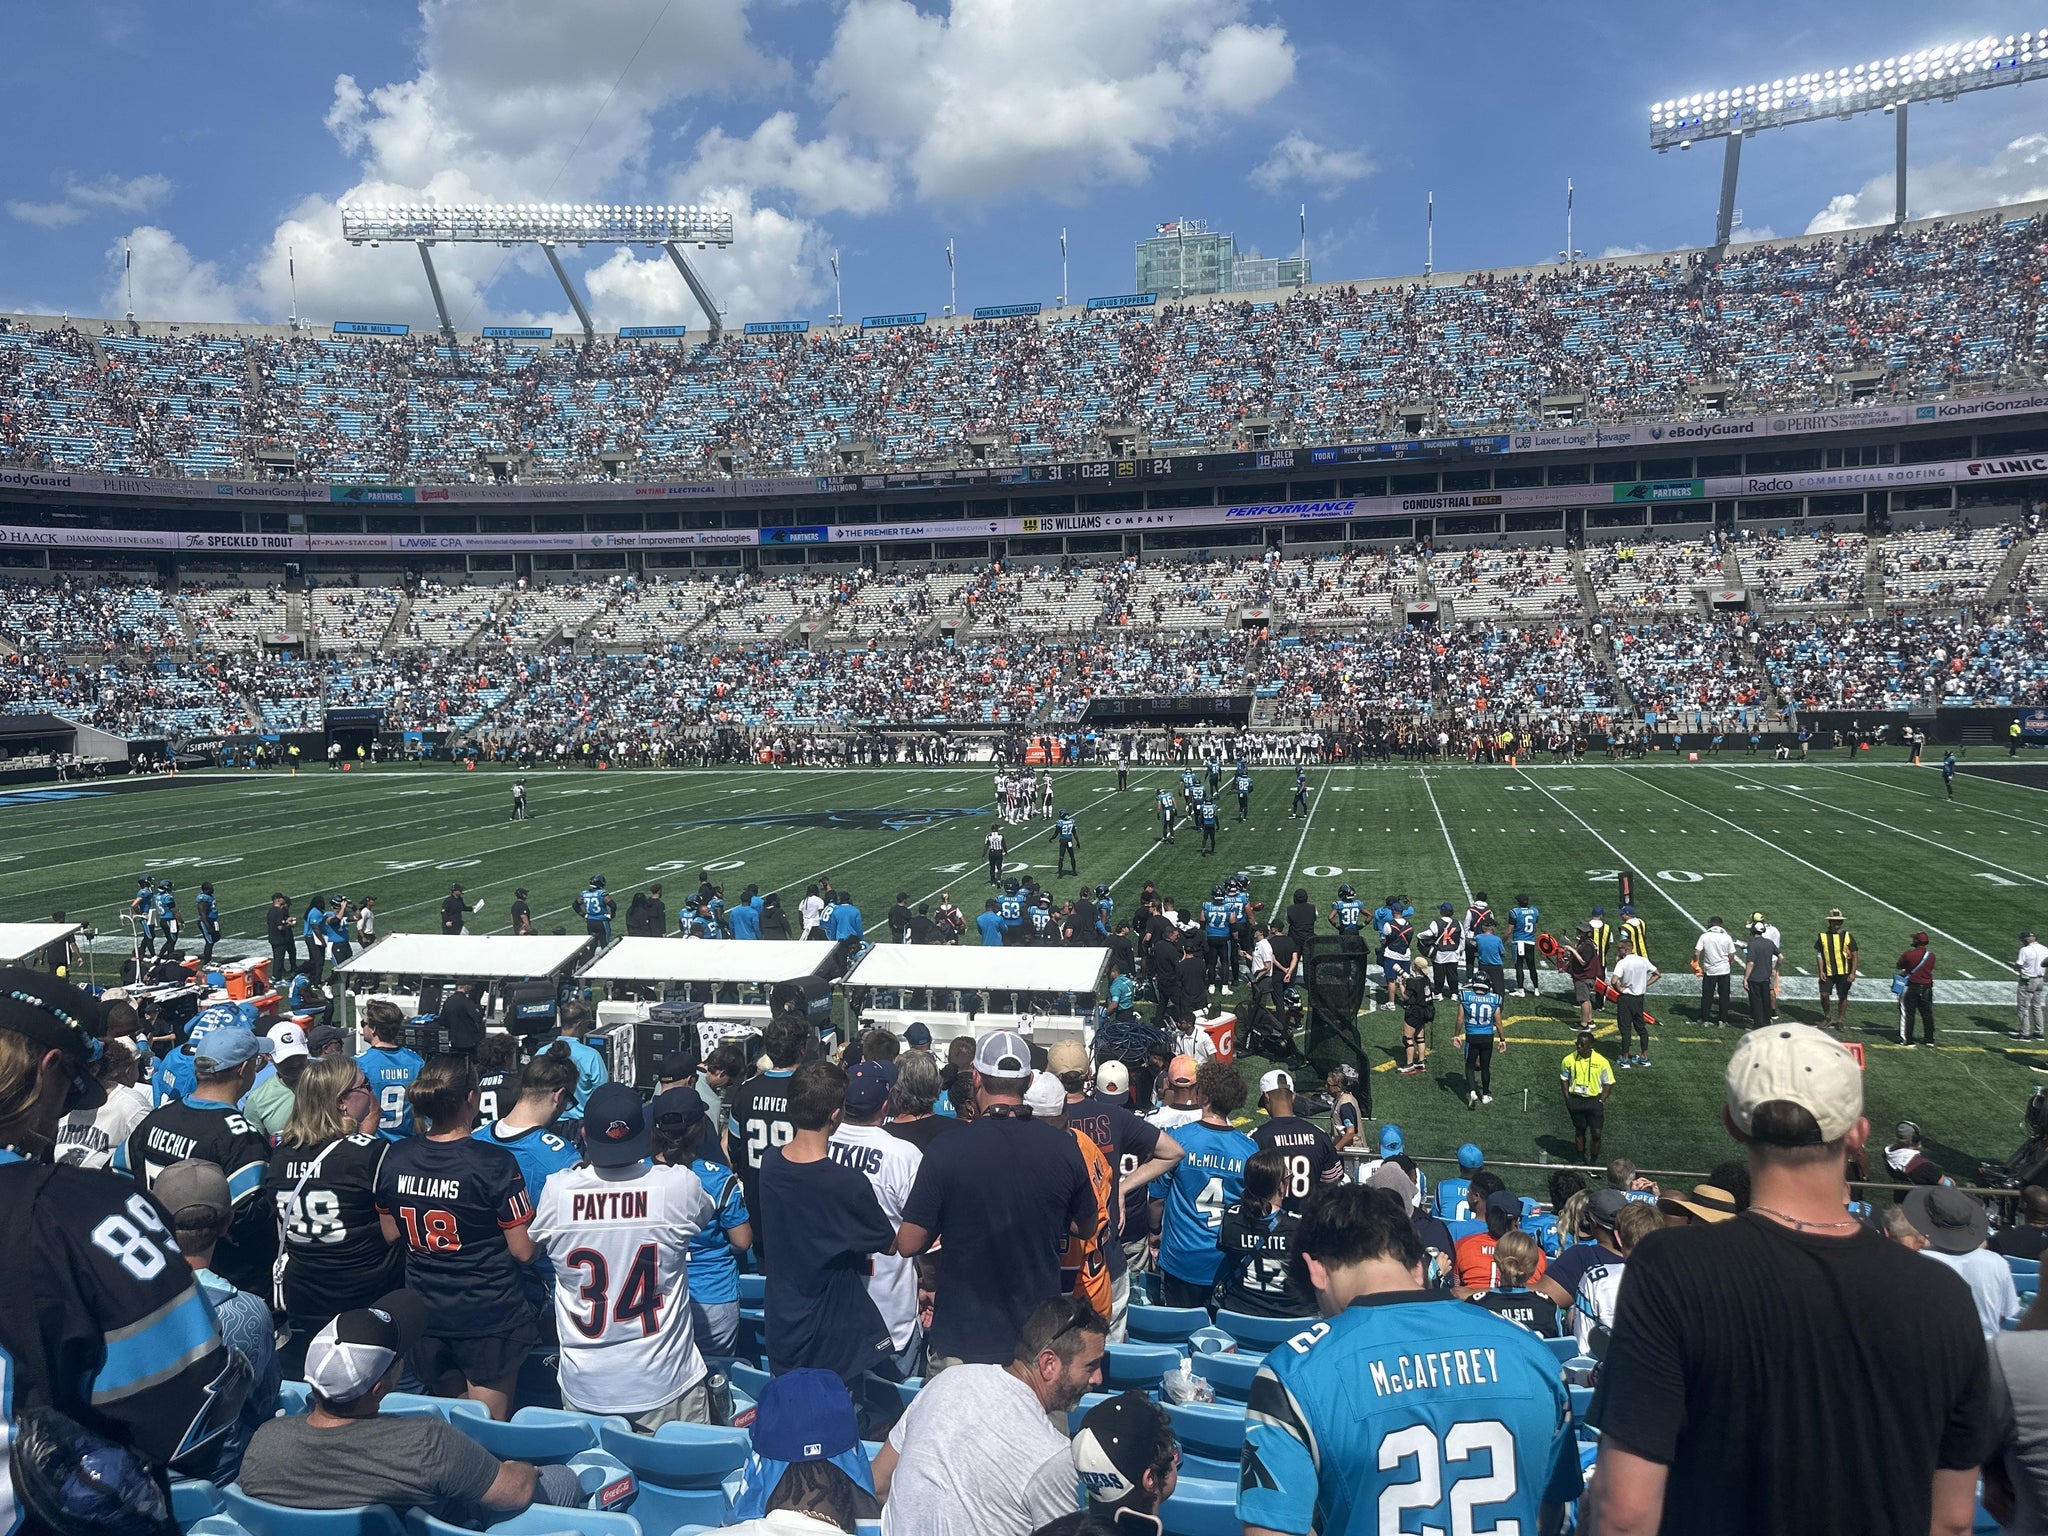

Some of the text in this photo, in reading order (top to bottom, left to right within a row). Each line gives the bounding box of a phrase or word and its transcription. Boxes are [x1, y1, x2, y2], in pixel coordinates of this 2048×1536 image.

[1095, 296, 1149, 307] JULIUS PEPPERS
[1002, 306, 1038, 315] MUHAMMAD
[897, 316, 917, 324] WALLS
[371, 325, 391, 333] MILLS
[1787, 415, 1839, 431] PERRY'S
[1839, 411, 1881, 420] DIAMONDS
[1839, 416, 1900, 426] ESTATE JEWELRY
[1668, 421, 1754, 438] eBodyGuard
[1535, 435, 1562, 447] Laxer,
[1563, 434, 1587, 448] Long
[1594, 431, 1631, 443] Savage
[1272, 450, 1294, 459] JALEN
[1314, 452, 1335, 461] TODAY
[1344, 446, 1376, 454] RECEPTIONS
[1259, 455, 1271, 466] 18
[1272, 458, 1295, 467] COKER
[1048, 466, 1063, 480] 31
[1081, 463, 1110, 477] 0:22
[1118, 461, 1134, 475] 25
[1153, 459, 1172, 474] 24
[817, 481, 827, 491] 14
[828, 483, 857, 492] RAYMOND
[1749, 468, 1946, 492] Radco COMMERCIAL ROOFING
[236, 486, 323, 498] KohariGonzalez
[368, 492, 403, 501] PARTNERS
[668, 486, 716, 494] ELECTRICAL
[1653, 488, 1692, 498] PARTNERS
[1226, 501, 1358, 517] PERFORMANCE
[1402, 496, 1471, 510] CONDUSTRIAL
[1040, 514, 1175, 531] HS WILLIAMS COMPANY
[10, 532, 58, 544] HAACK
[66, 535, 114, 543] DIAMONDS
[118, 536, 139, 544] FINE
[140, 537, 164, 545] GEMS
[606, 532, 751, 546] Fisher Improvement Technologies
[789, 532, 819, 542] PARTNERS
[845, 529, 863, 537] THE
[863, 528, 899, 537] PREMIER
[901, 527, 924, 536] TEAM
[186, 534, 294, 548] The SPECKLED TROUT
[440, 538, 462, 547] CPA
[1113, 698, 1231, 713] 31 0:22 25 24
[1061, 823, 1074, 835] 27
[1239, 865, 1343, 877] 30
[584, 897, 602, 914] 73
[1001, 901, 1020, 919] 63
[1208, 911, 1228, 928] 77
[1341, 908, 1360, 925] 30
[1523, 915, 1534, 933] 6
[1467, 1003, 1493, 1026] 10
[1218, 1032, 1233, 1056] G
[379, 1067, 409, 1080] YOUNG
[379, 1085, 407, 1130] 9
[752, 1096, 788, 1113] CARVER
[147, 1126, 198, 1160] KUECHLY
[541, 1132, 566, 1152] 9
[1273, 1133, 1315, 1147] WILLIAMS
[828, 1140, 883, 1175] TKUS
[1187, 1152, 1242, 1174] McMILLAN
[286, 1161, 322, 1179] OLSEN
[397, 1174, 460, 1200] WILLIAMS
[571, 1191, 649, 1223] PAYTON
[1195, 1177, 1226, 1228] 4
[399, 1206, 463, 1254] 18
[566, 1242, 665, 1340] 34
[1287, 1322, 1332, 1354] 2
[1368, 1348, 1499, 1398] McCAFFREY
[1377, 1419, 1521, 1536] 22
